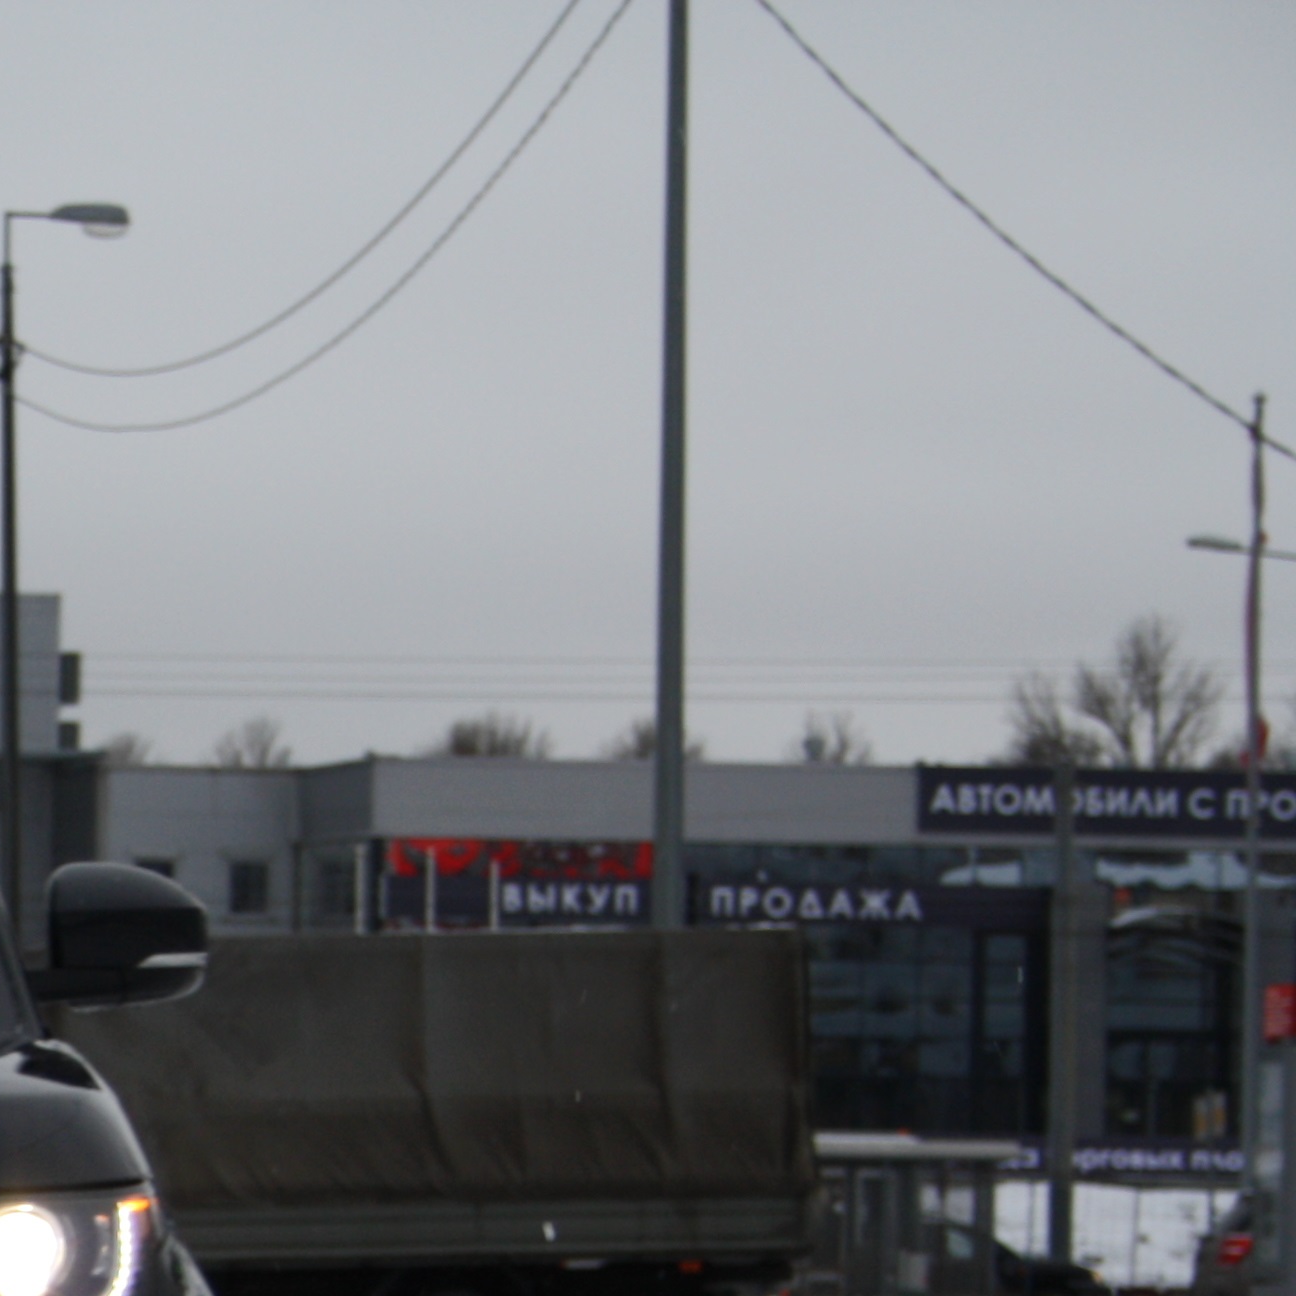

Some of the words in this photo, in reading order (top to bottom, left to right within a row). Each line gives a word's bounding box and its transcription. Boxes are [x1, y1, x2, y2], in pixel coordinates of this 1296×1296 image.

[1186, 787, 1216, 821] С
[502, 883, 642, 917] ВЫКУП
[709, 885, 924, 921] ПРОДАЖА
